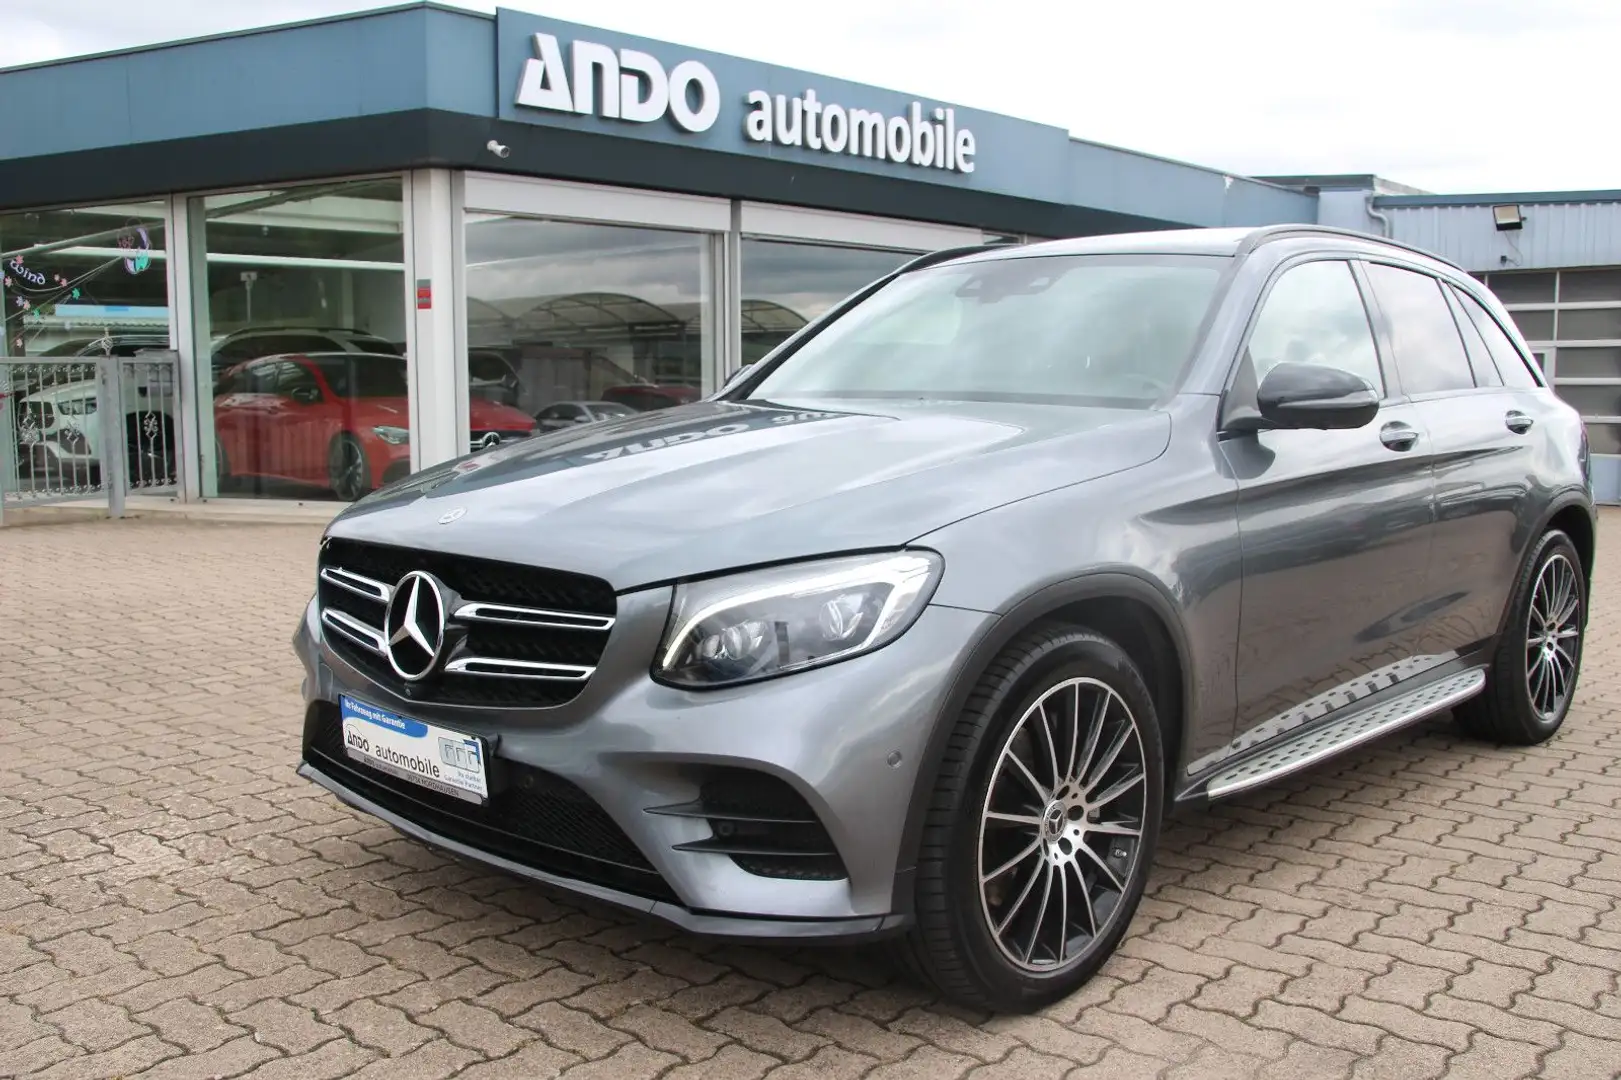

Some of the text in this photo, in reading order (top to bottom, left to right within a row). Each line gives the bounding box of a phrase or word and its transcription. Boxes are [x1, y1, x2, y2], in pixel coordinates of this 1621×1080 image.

[515, 32, 976, 174] ANDO automobile
[381, 714, 406, 729] Garantie
[347, 730, 370, 752] ANDO
[375, 744, 440, 778] automobile
